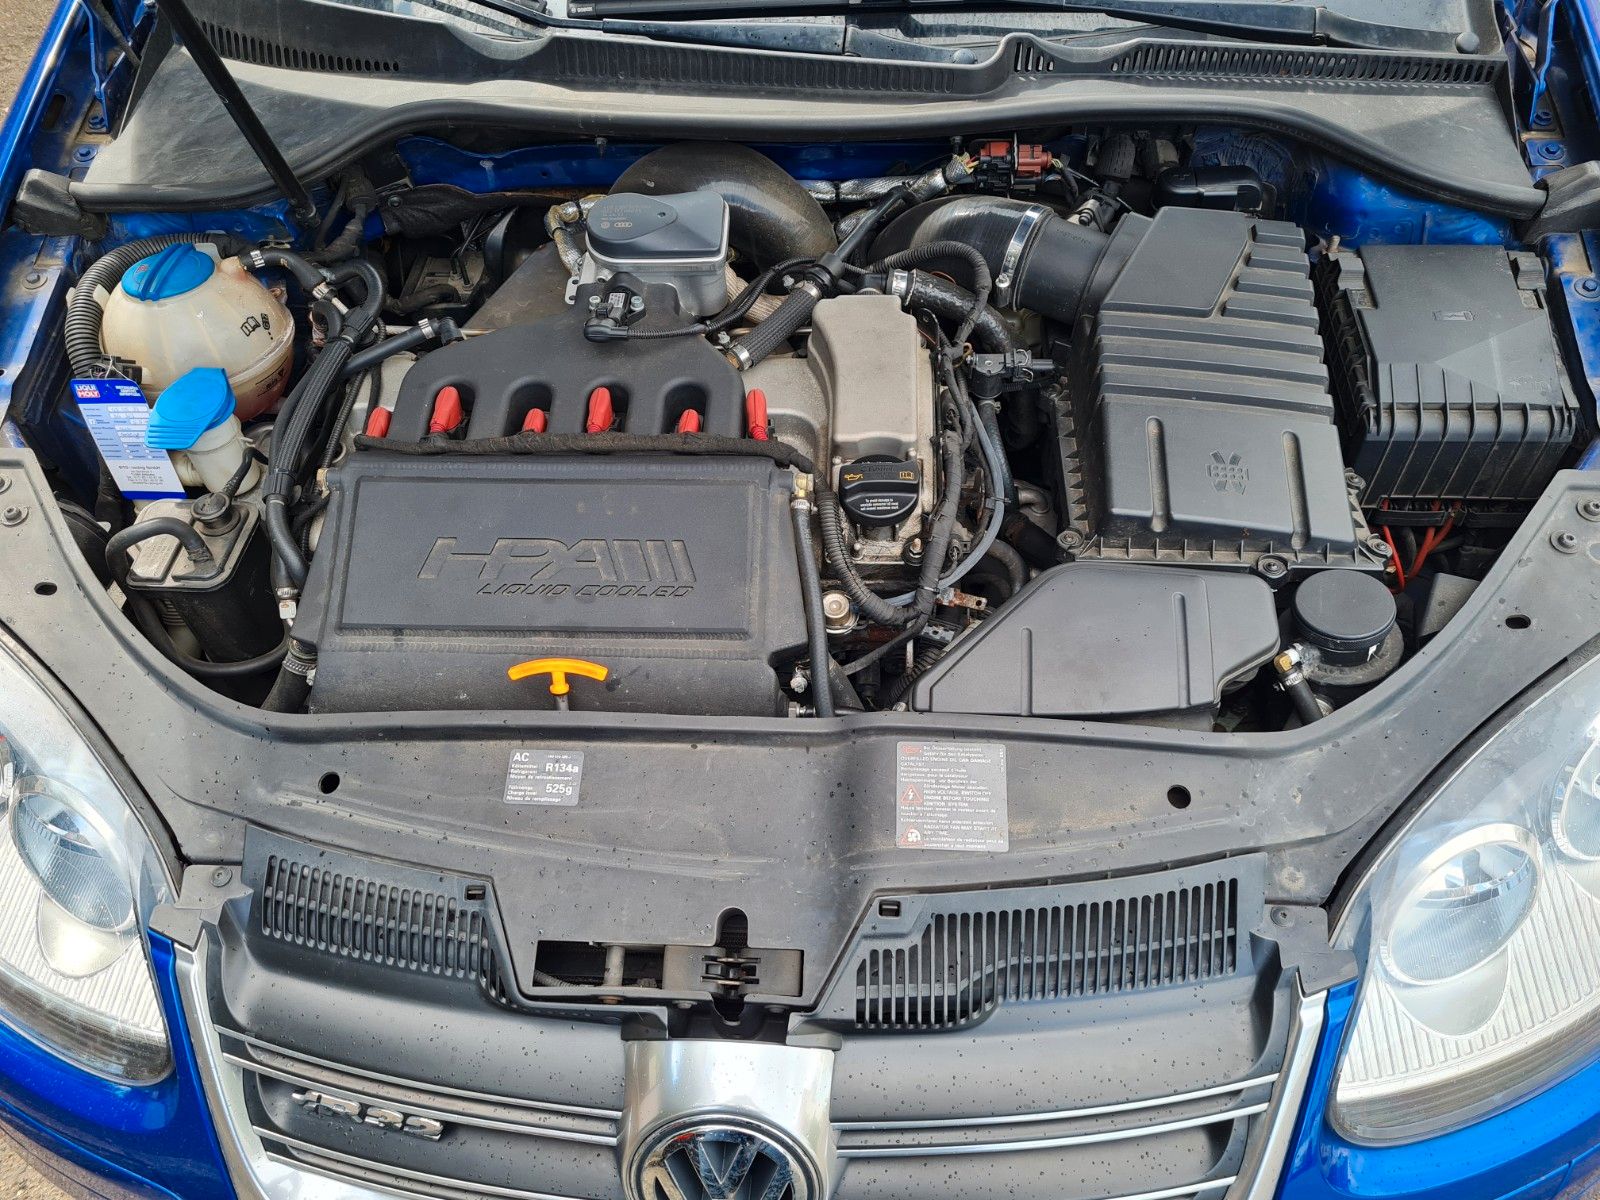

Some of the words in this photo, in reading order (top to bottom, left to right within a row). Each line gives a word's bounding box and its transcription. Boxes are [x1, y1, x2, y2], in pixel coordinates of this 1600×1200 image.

[77, 390, 100, 398] MOLY
[476, 583, 571, 595] LIQUID
[574, 584, 694, 597] COOLED
[512, 752, 530, 762] AC
[545, 762, 579, 773] R134a
[546, 784, 572, 796] 525g
